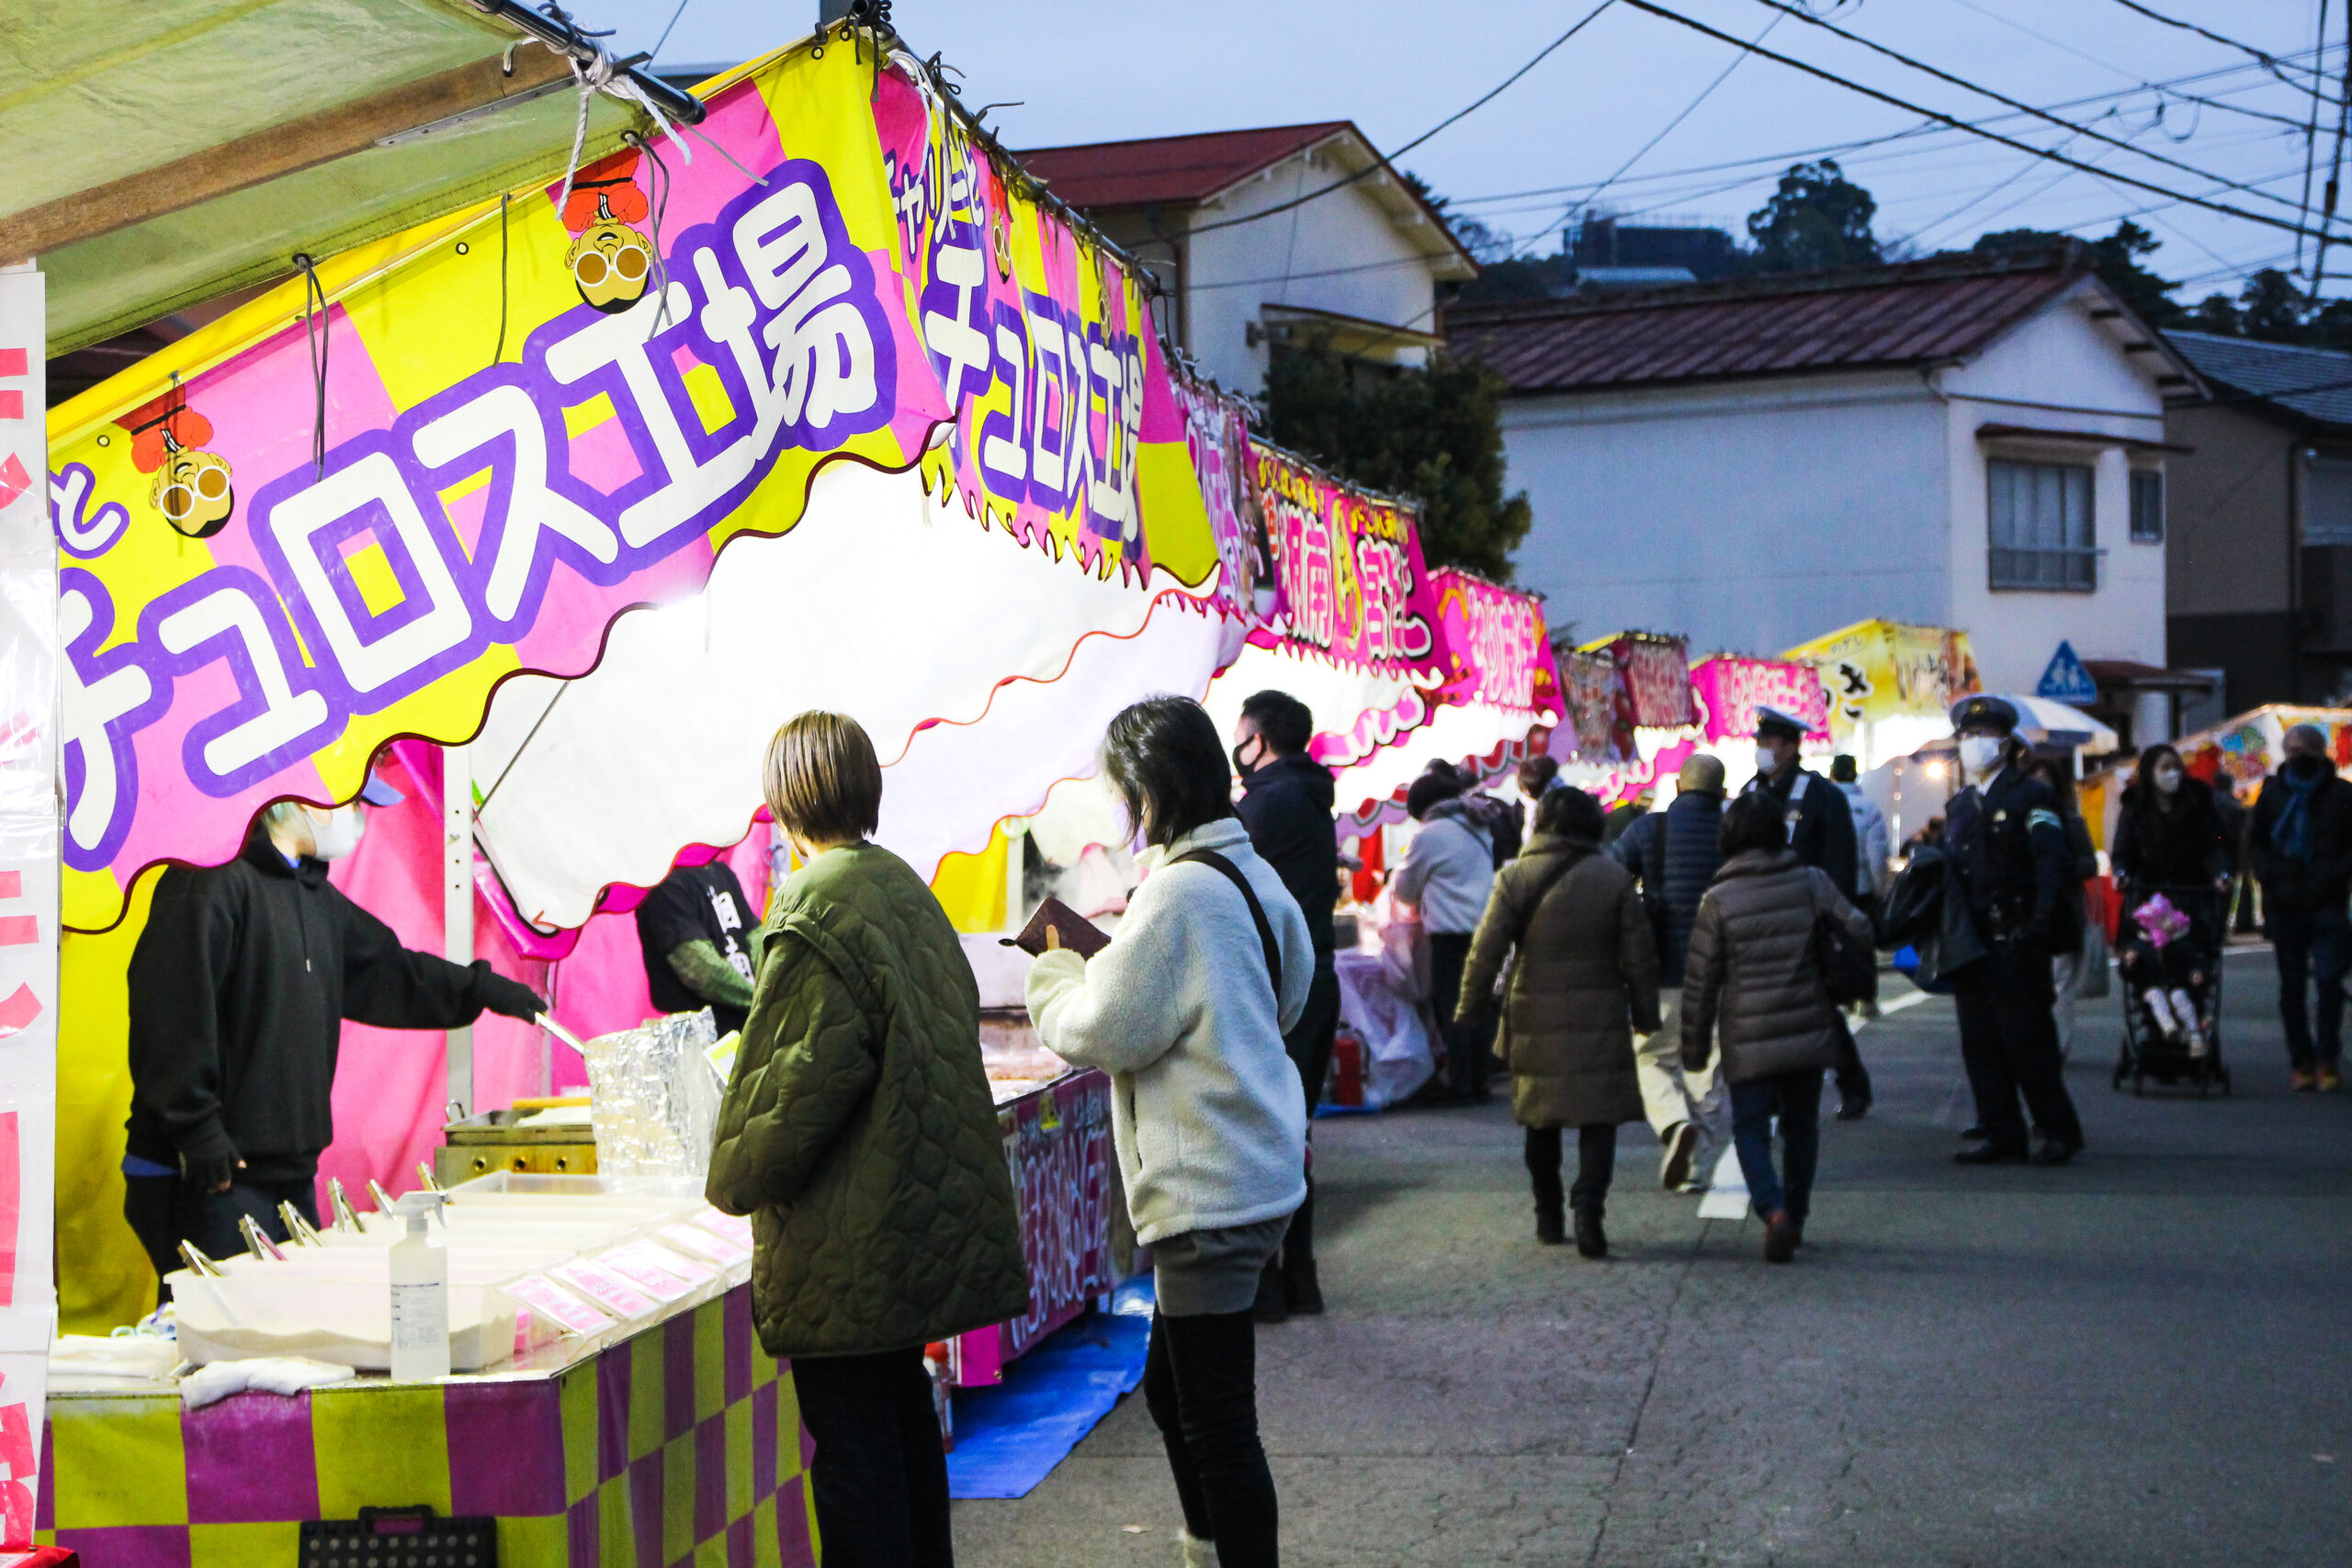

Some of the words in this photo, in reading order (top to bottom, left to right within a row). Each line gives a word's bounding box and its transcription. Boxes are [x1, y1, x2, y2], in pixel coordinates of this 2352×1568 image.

[61, 175, 884, 856] チュロス工場
[924, 244, 1145, 542] チュロス工場
